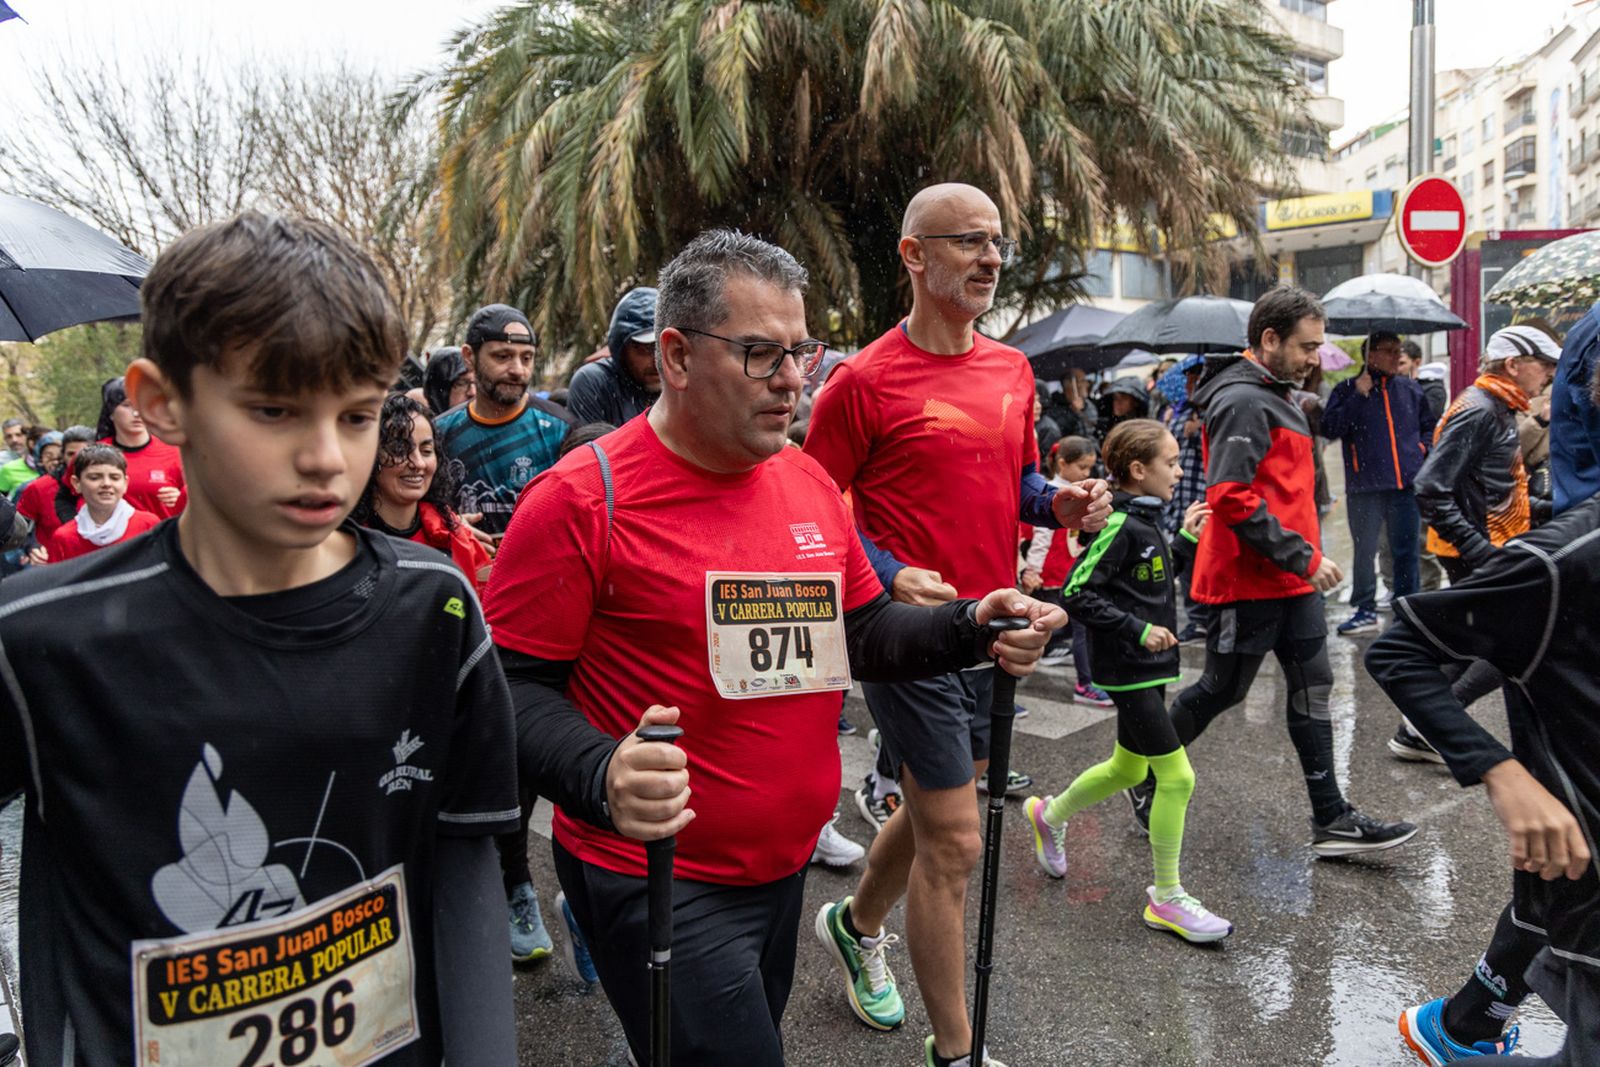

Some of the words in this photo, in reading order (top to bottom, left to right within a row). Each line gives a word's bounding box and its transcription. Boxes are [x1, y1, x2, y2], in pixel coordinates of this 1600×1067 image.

[717, 605, 726, 621] V
[729, 602, 784, 621] CARRERA
[786, 601, 834, 619] POPULAR
[720, 583, 738, 599] IES
[741, 583, 762, 599] San
[766, 583, 792, 599] Juan
[795, 583, 828, 598] Bosco
[748, 626, 814, 672] 874
[159, 990, 180, 1019] V
[188, 961, 307, 1013] CARRERA
[311, 915, 395, 980] POPULAR
[166, 953, 209, 986] IES
[217, 945, 269, 976] San
[275, 925, 329, 961] Juan
[331, 895, 385, 936] Bosco
[228, 977, 356, 1067] 286
